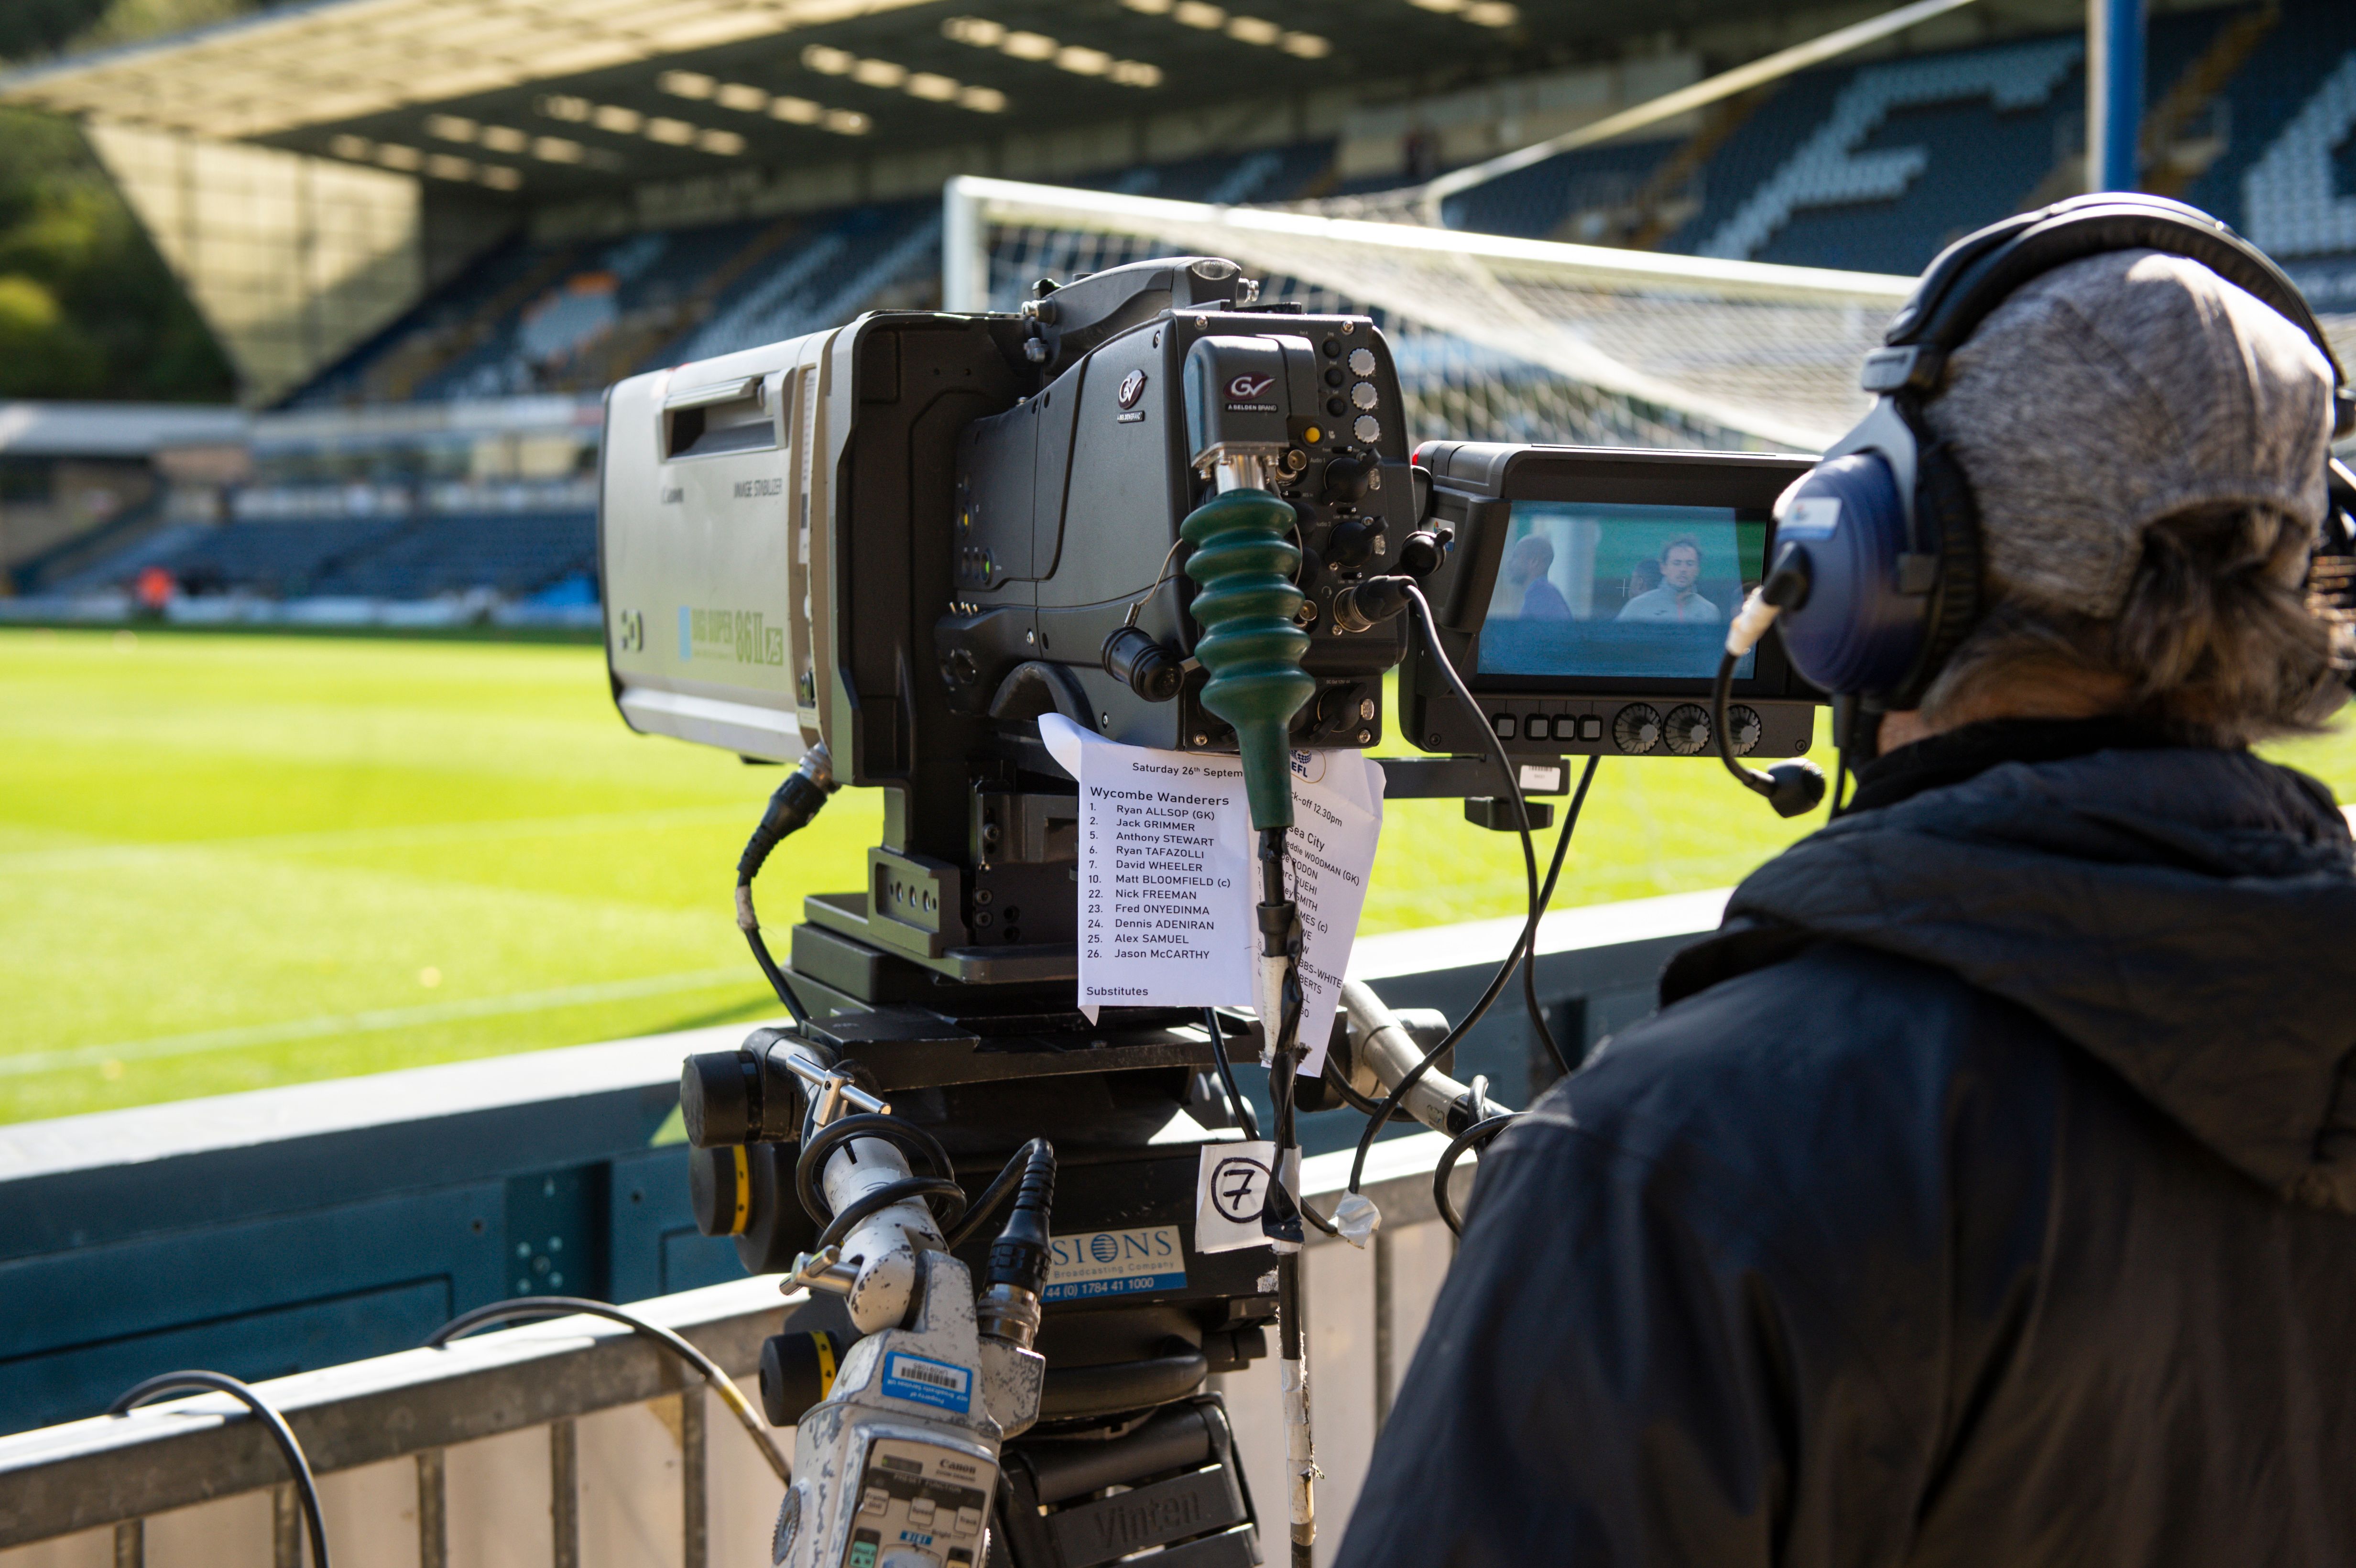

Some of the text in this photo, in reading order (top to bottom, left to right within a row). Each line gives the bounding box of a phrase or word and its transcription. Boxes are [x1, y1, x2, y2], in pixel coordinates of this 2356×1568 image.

[1133, 763, 1243, 778] Saturday 26th Septem
[1291, 761, 1308, 778] EFL
[1091, 786, 1229, 806] Wycombe Wanderers
[1090, 803, 1215, 821] 1. Ryan ALLSOP (GK)
[1314, 804, 1342, 827] 12.30pm
[1116, 819, 1141, 828] Jack
[1144, 820, 1195, 831] GRIMMER
[1116, 832, 1160, 844] Anthony
[1164, 835, 1214, 846] STEWART
[1307, 833, 1325, 852] City
[1089, 846, 1204, 859] 6. Ryan TAFAZOLLI
[1089, 860, 1202, 872] 7. David WHEELER
[1292, 858, 1318, 880] RODON
[1305, 851, 1341, 876] WOODMAN
[1342, 870, 1360, 886] (GK)
[1089, 875, 1231, 888] 10. Matt BLOOMFIELD (c)
[1295, 876, 1317, 895] GUEHI
[1088, 889, 1197, 900] 22. Nick FREEMAN
[1296, 892, 1318, 912] SMITH
[1088, 904, 1210, 915] 23. Fred ONYEDINMA
[1088, 919, 1214, 930] 24. Dennis ADENIRAN
[1318, 921, 1328, 934] (c)
[1088, 934, 1189, 944] 25. Alex SAMUEL
[1087, 949, 1210, 959] 26. Jason McCARTHY
[1087, 987, 1148, 996] Substitutes
[1223, 1169, 1255, 1210] 7
[1054, 1261, 1175, 1279] Broadcasting Company
[1063, 1284, 1078, 1297] (0)
[1081, 1282, 1108, 1294] 1784
[1111, 1280, 1123, 1291] 41
[1128, 1277, 1154, 1289] 1000
[918, 1393, 945, 1404] Property
[939, 1458, 976, 1474] Canon
[925, 1478, 962, 1493] FUNCTION
[1094, 1491, 1201, 1549] Vinten
